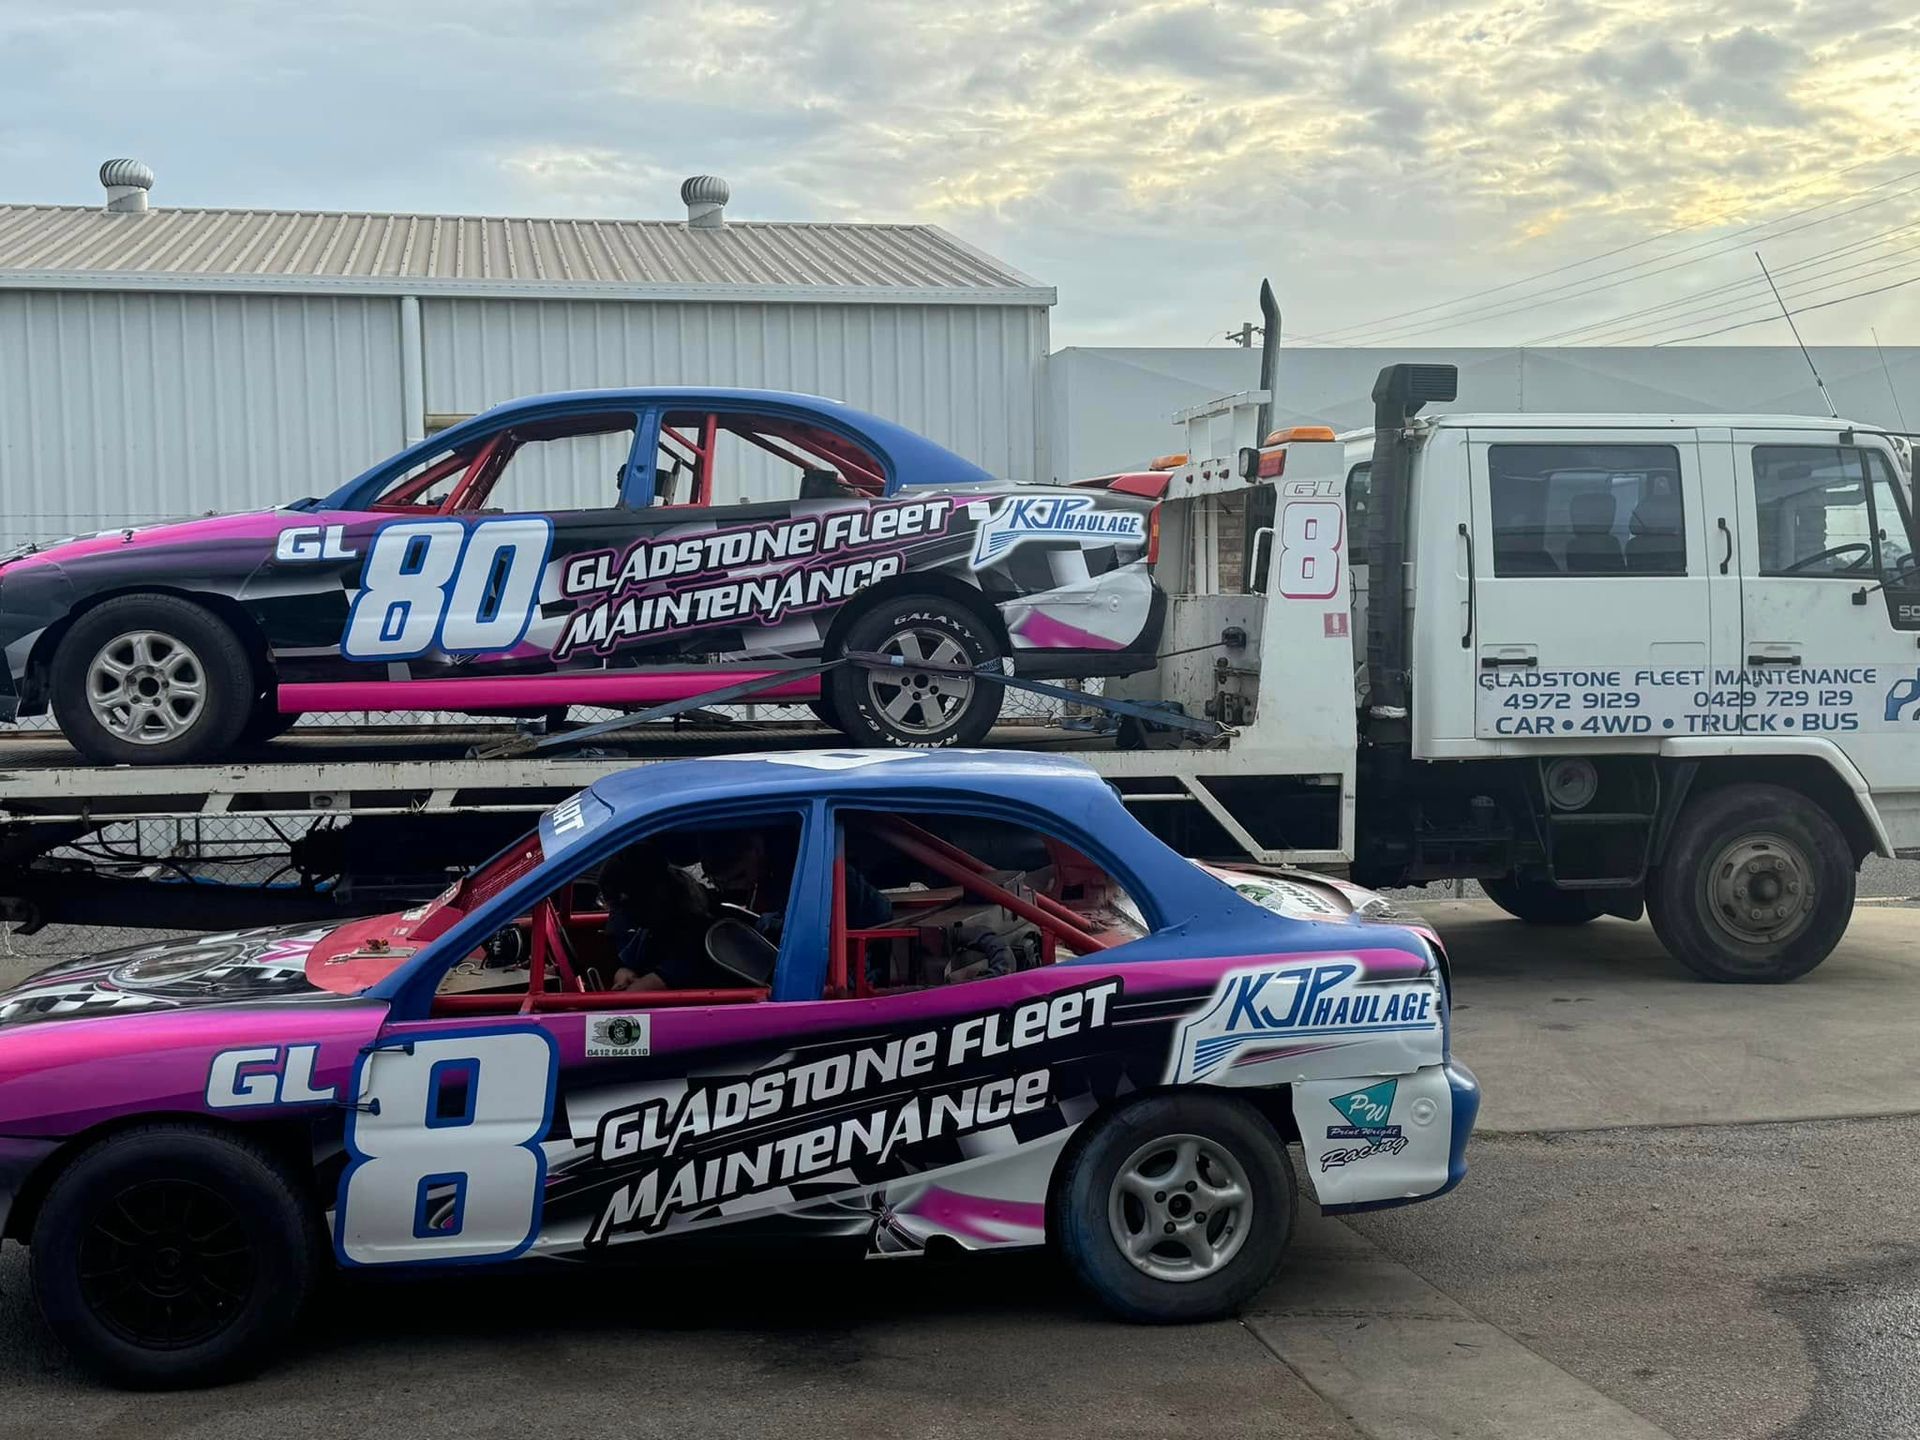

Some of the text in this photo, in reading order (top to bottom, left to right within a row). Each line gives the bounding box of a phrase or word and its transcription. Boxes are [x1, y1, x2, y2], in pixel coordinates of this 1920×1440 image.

[1283, 481, 1342, 497] GL
[1009, 498, 1139, 534] KJP HAULAGE
[276, 525, 357, 561] GL
[1278, 501, 1344, 600] 8
[342, 516, 553, 660] 80
[894, 612, 975, 639] GALAXY
[1478, 669, 1877, 688] GLADSTONE FLEET MAINTENANCE
[1503, 690, 1853, 709] 4972 9129 0429 729 129
[1495, 712, 1858, 734] CAR 4WD TRUCK BUS
[1225, 964, 1432, 1031] KJP HAULAGE
[205, 1045, 337, 1108] GL
[338, 1028, 556, 1266] 8
[1320, 1136, 1409, 1173] Racing
